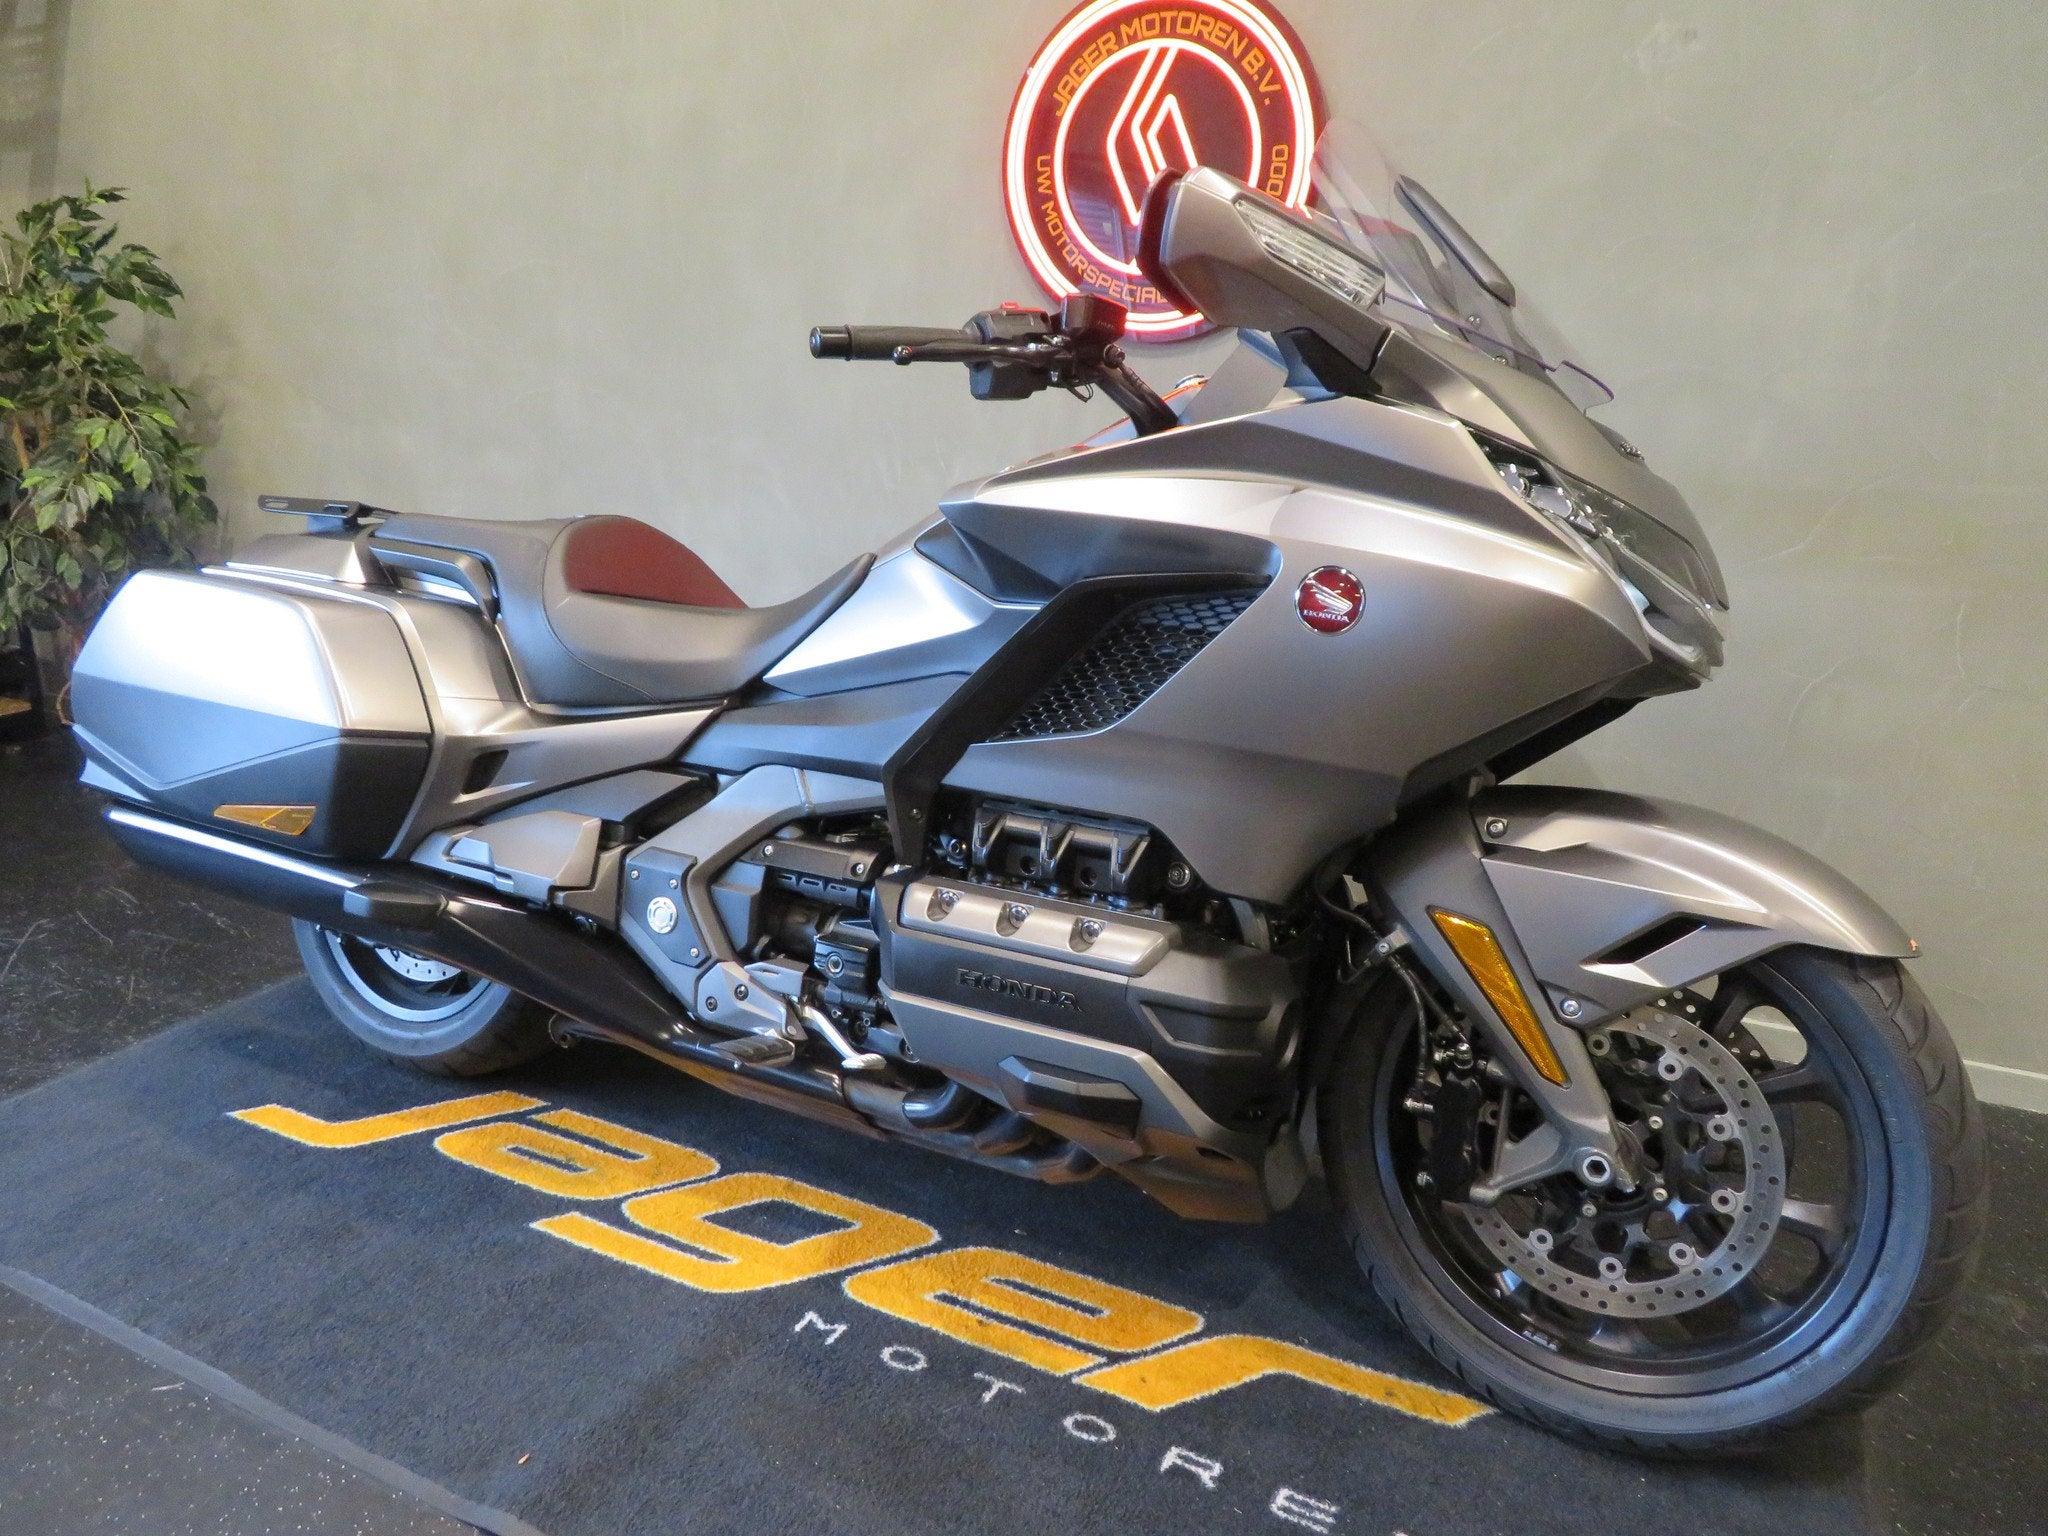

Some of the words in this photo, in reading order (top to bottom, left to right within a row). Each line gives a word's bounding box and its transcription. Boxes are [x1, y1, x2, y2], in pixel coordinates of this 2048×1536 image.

[1053, 31, 1119, 117] JAGER
[1120, 10, 1249, 58] MOTOREN
[1241, 47, 1282, 106] B.V.
[1036, 155, 1053, 195] UW
[1303, 609, 1350, 623] HONDA
[956, 967, 1085, 1012] HONDA
[794, 1311, 1409, 1536] MOTORE
